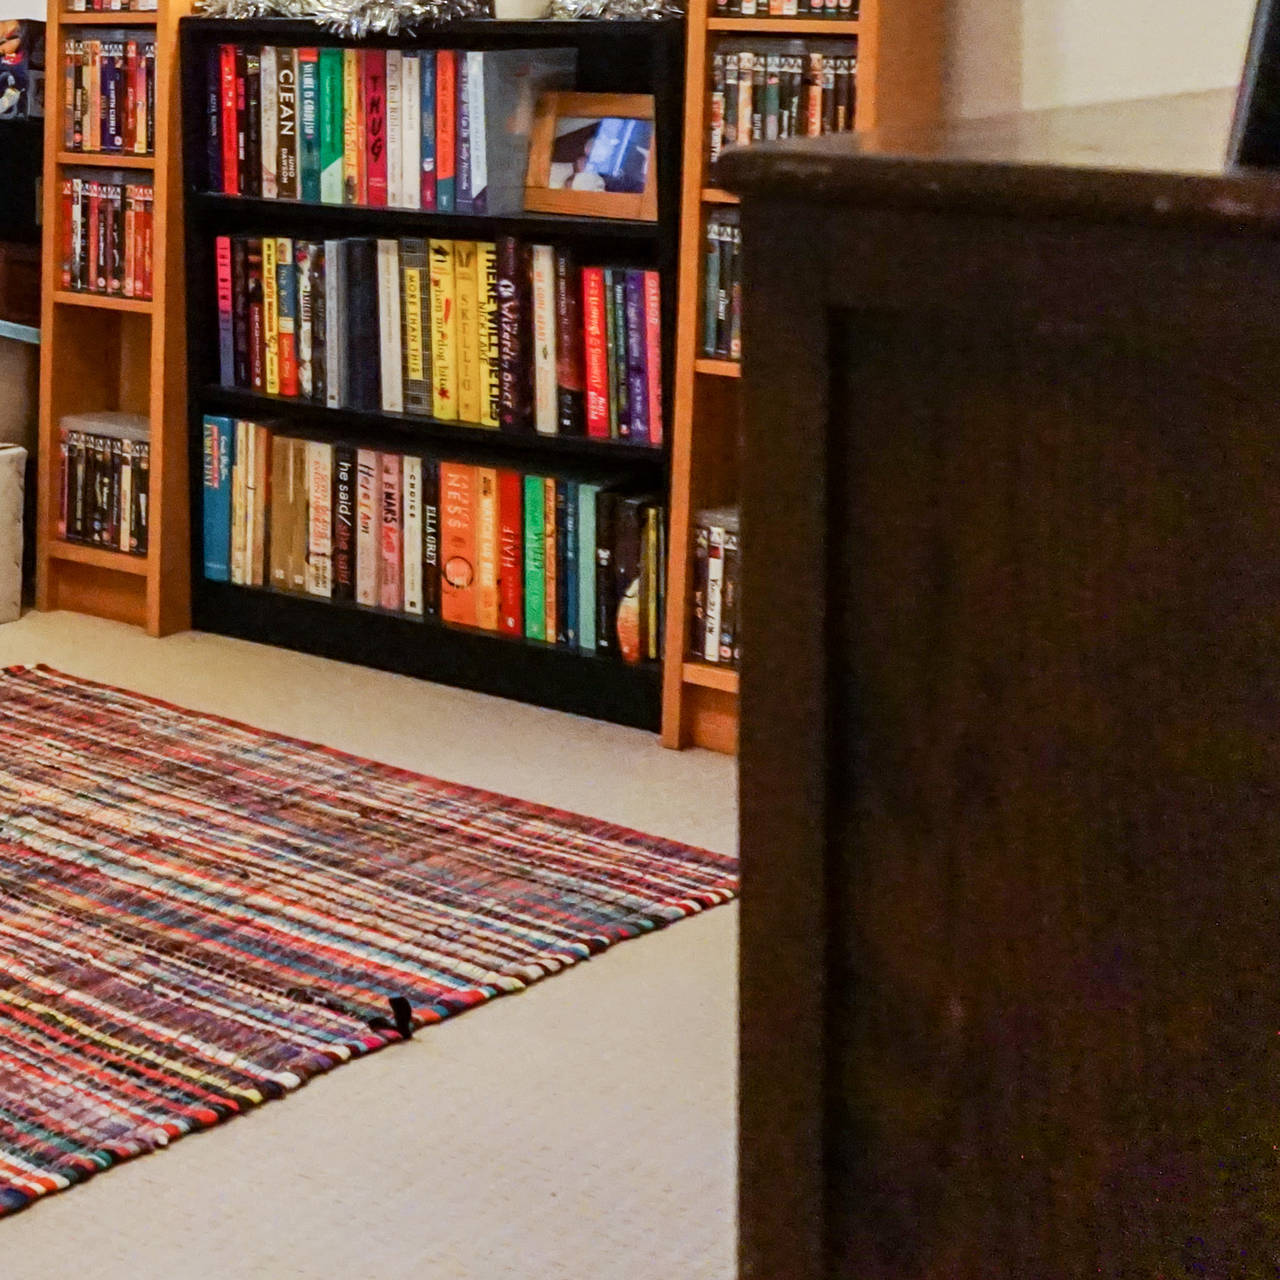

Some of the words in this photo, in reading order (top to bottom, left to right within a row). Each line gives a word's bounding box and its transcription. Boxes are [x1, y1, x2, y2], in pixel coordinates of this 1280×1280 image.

[408, 274, 416, 306] MORE
[486, 249, 499, 307] THERE
[410, 312, 418, 342] THAN
[479, 301, 488, 329] NICK
[488, 311, 500, 353] WILL
[502, 301, 516, 360] Wizards
[411, 348, 420, 374] THIS
[436, 339, 448, 361] dog
[480, 336, 488, 364] LAKE
[489, 358, 500, 379] BE
[502, 372, 512, 408] ONCE
[339, 462, 352, 480] he
[384, 492, 397, 524] MARS
[448, 473, 461, 529] NESS
[426, 505, 436, 534] ELLA
[426, 536, 436, 566] GREY
